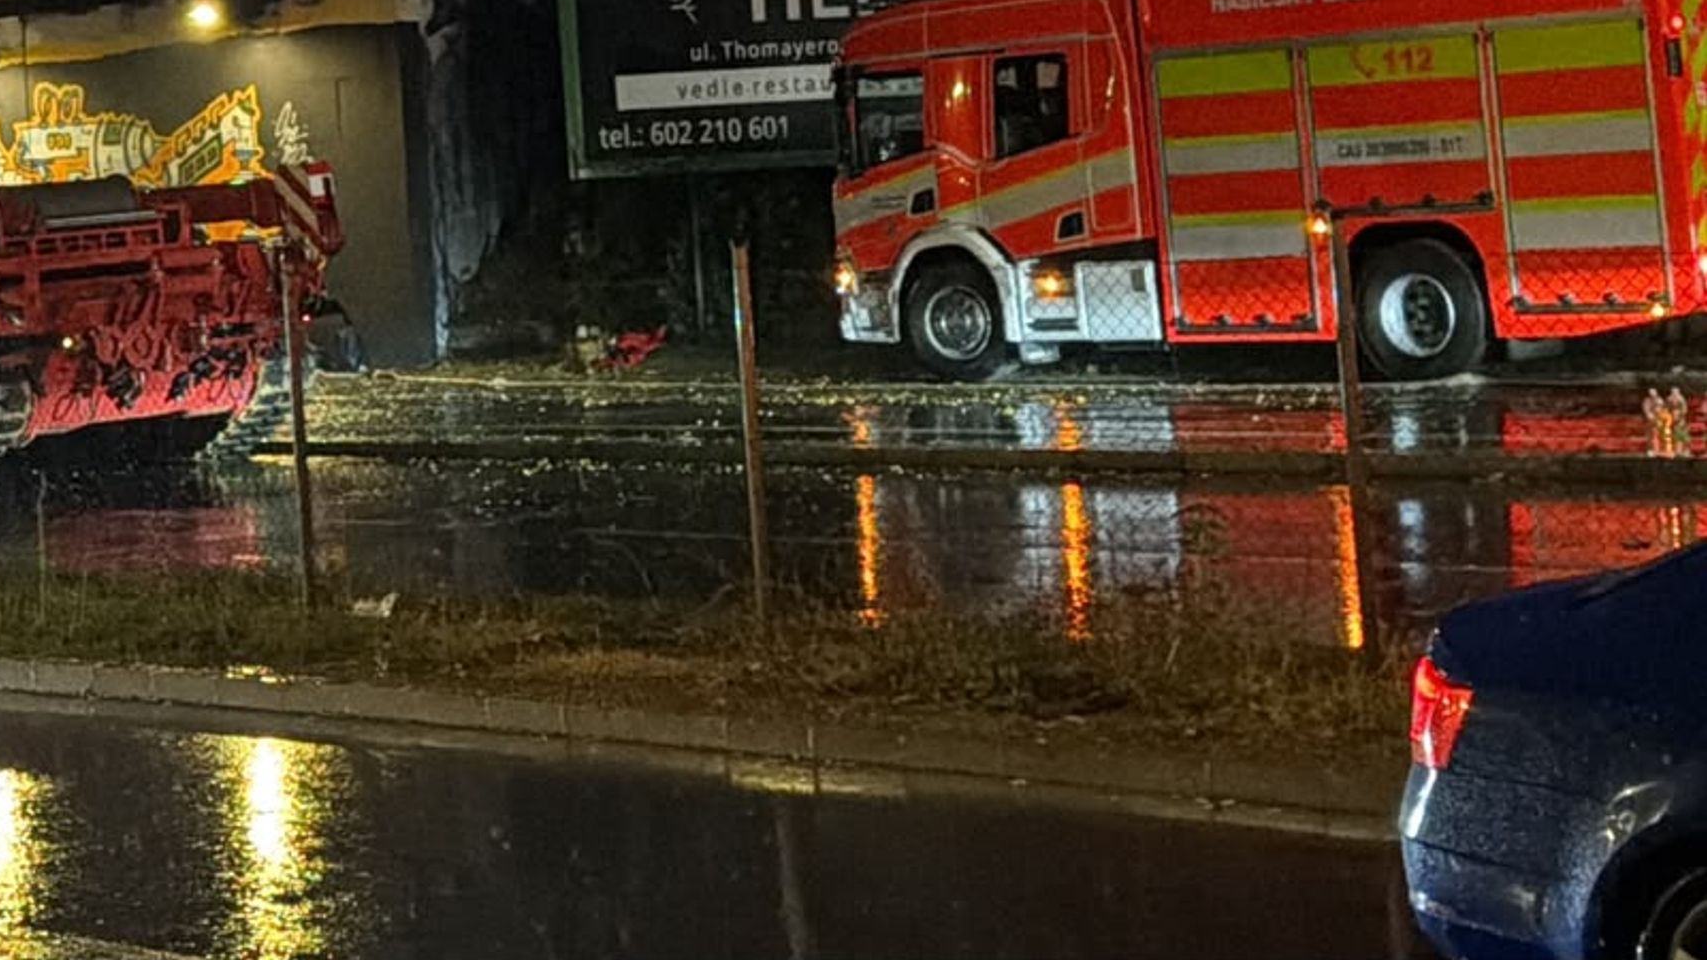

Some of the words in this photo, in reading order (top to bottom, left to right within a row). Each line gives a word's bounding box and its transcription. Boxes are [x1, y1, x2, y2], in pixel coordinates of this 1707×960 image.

[689, 42, 718, 63] ul.
[1382, 45, 1434, 75] 112
[753, 73, 834, 97] restau
[650, 120, 696, 147] 602
[700, 117, 742, 144] 210
[747, 114, 790, 141] 601
